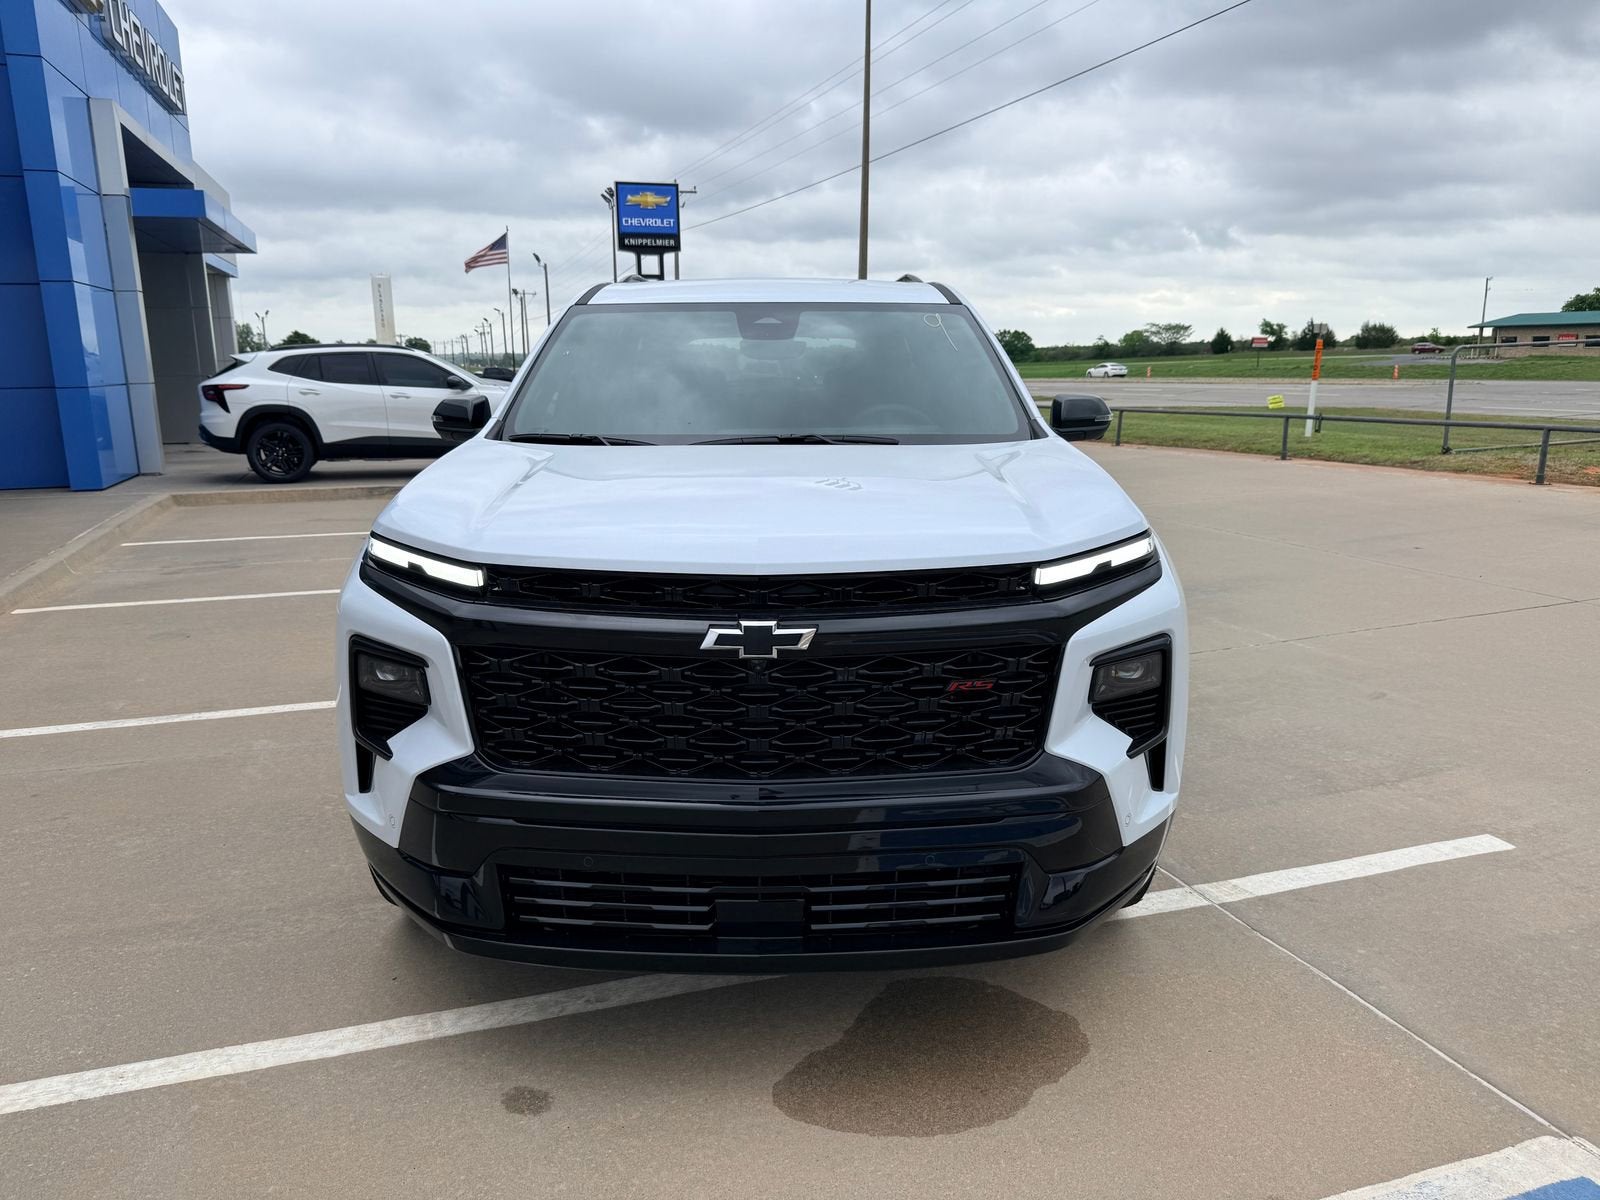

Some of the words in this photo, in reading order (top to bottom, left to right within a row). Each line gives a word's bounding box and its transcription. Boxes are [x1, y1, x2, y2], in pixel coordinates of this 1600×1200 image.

[622, 217, 675, 227] CHEVROLET
[624, 238, 675, 246] KNIPPELMIER
[947, 681, 994, 692] RS
